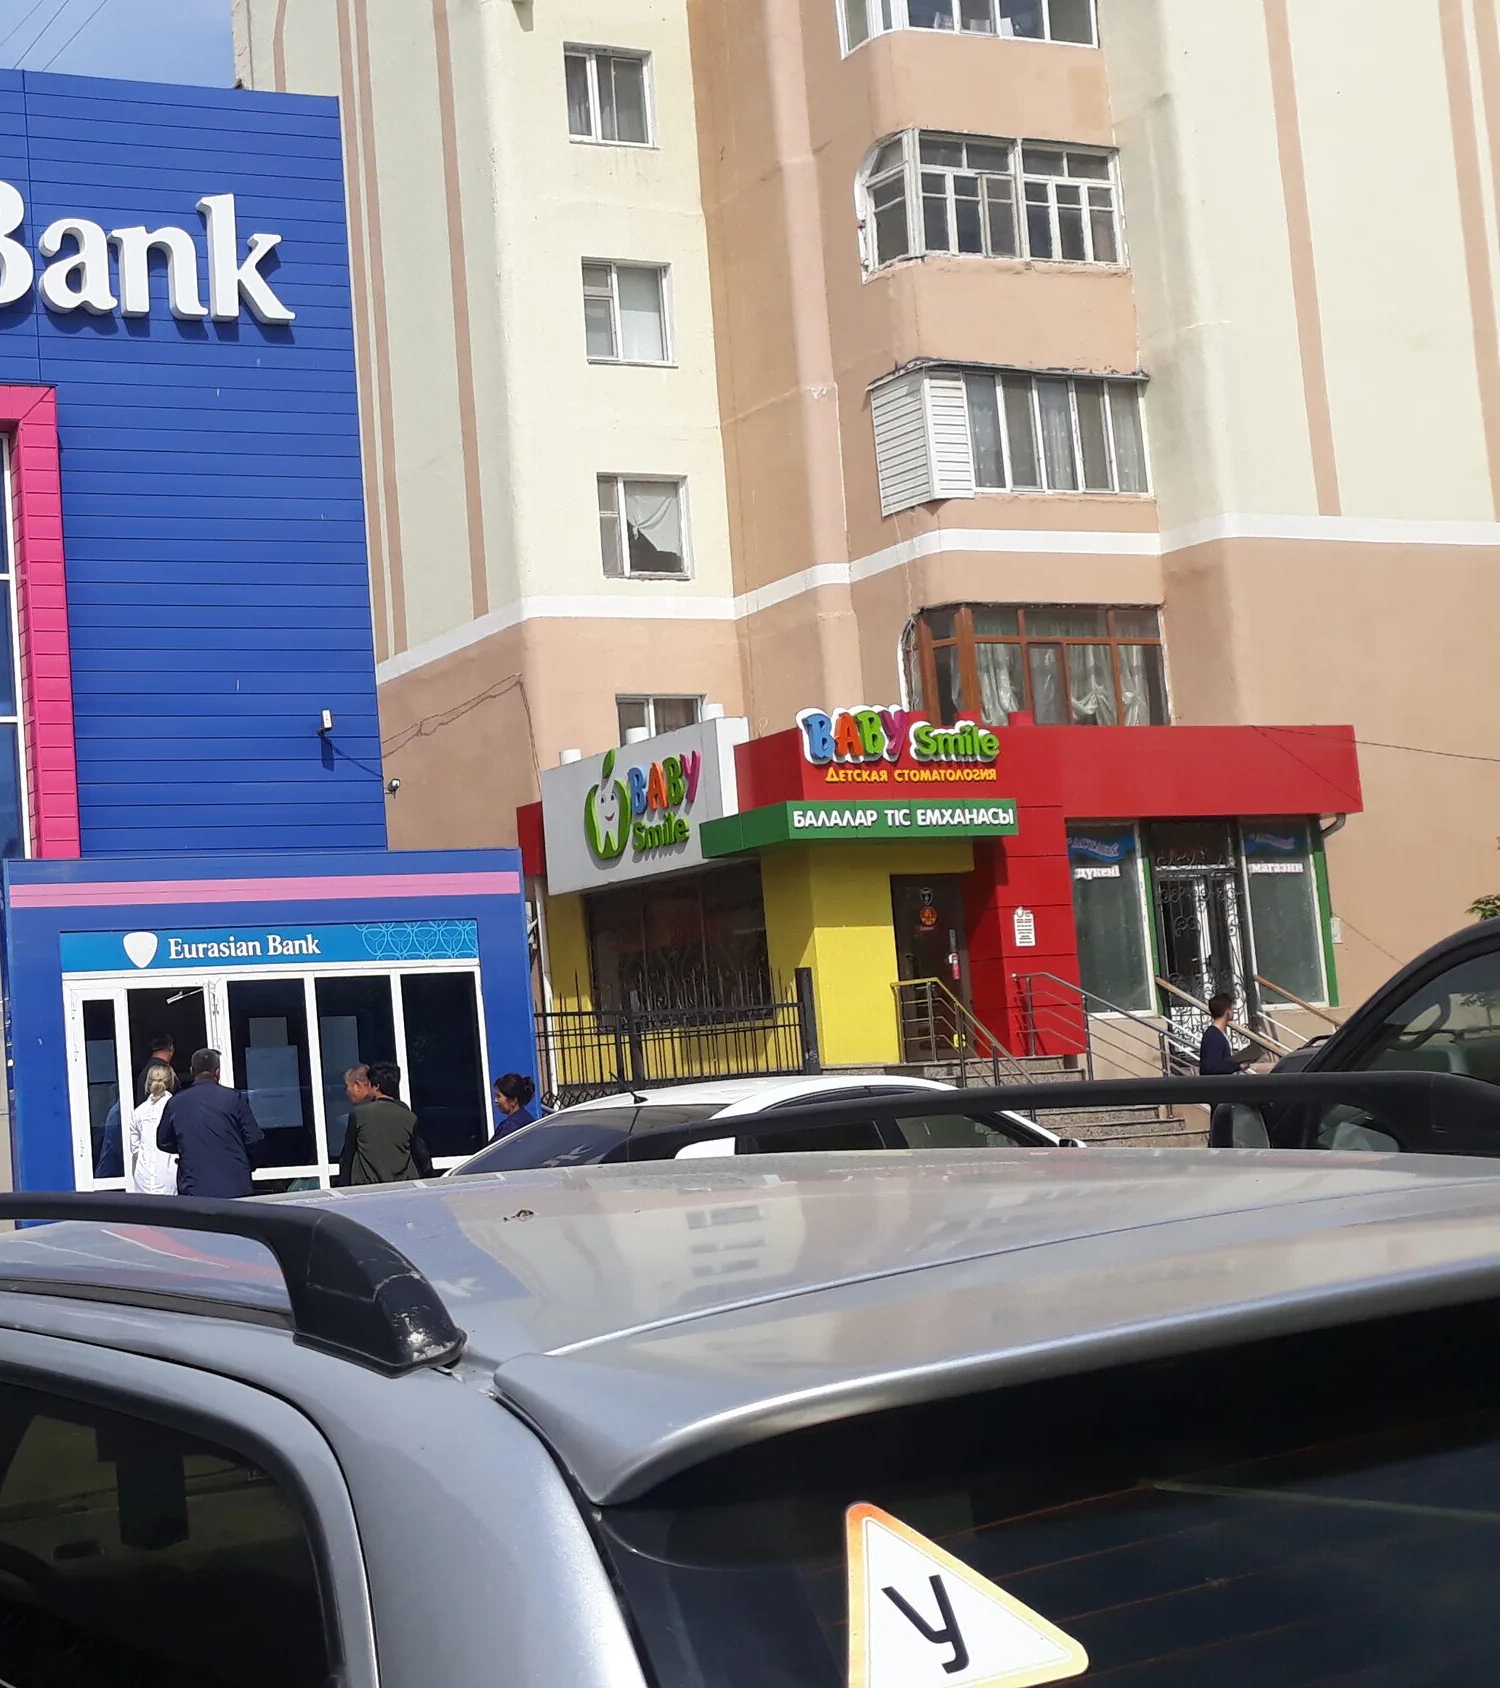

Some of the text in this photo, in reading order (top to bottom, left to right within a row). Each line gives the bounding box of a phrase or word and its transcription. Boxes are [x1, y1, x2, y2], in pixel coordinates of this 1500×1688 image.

[802, 709, 1000, 759] BABY Smile
[627, 750, 701, 815] BABY
[632, 811, 690, 853] Smile
[793, 809, 878, 828] БАЛАЛАР
[916, 807, 1014, 826] ЕМХАНАСЫ
[168, 933, 322, 960] Eurasian Bank
